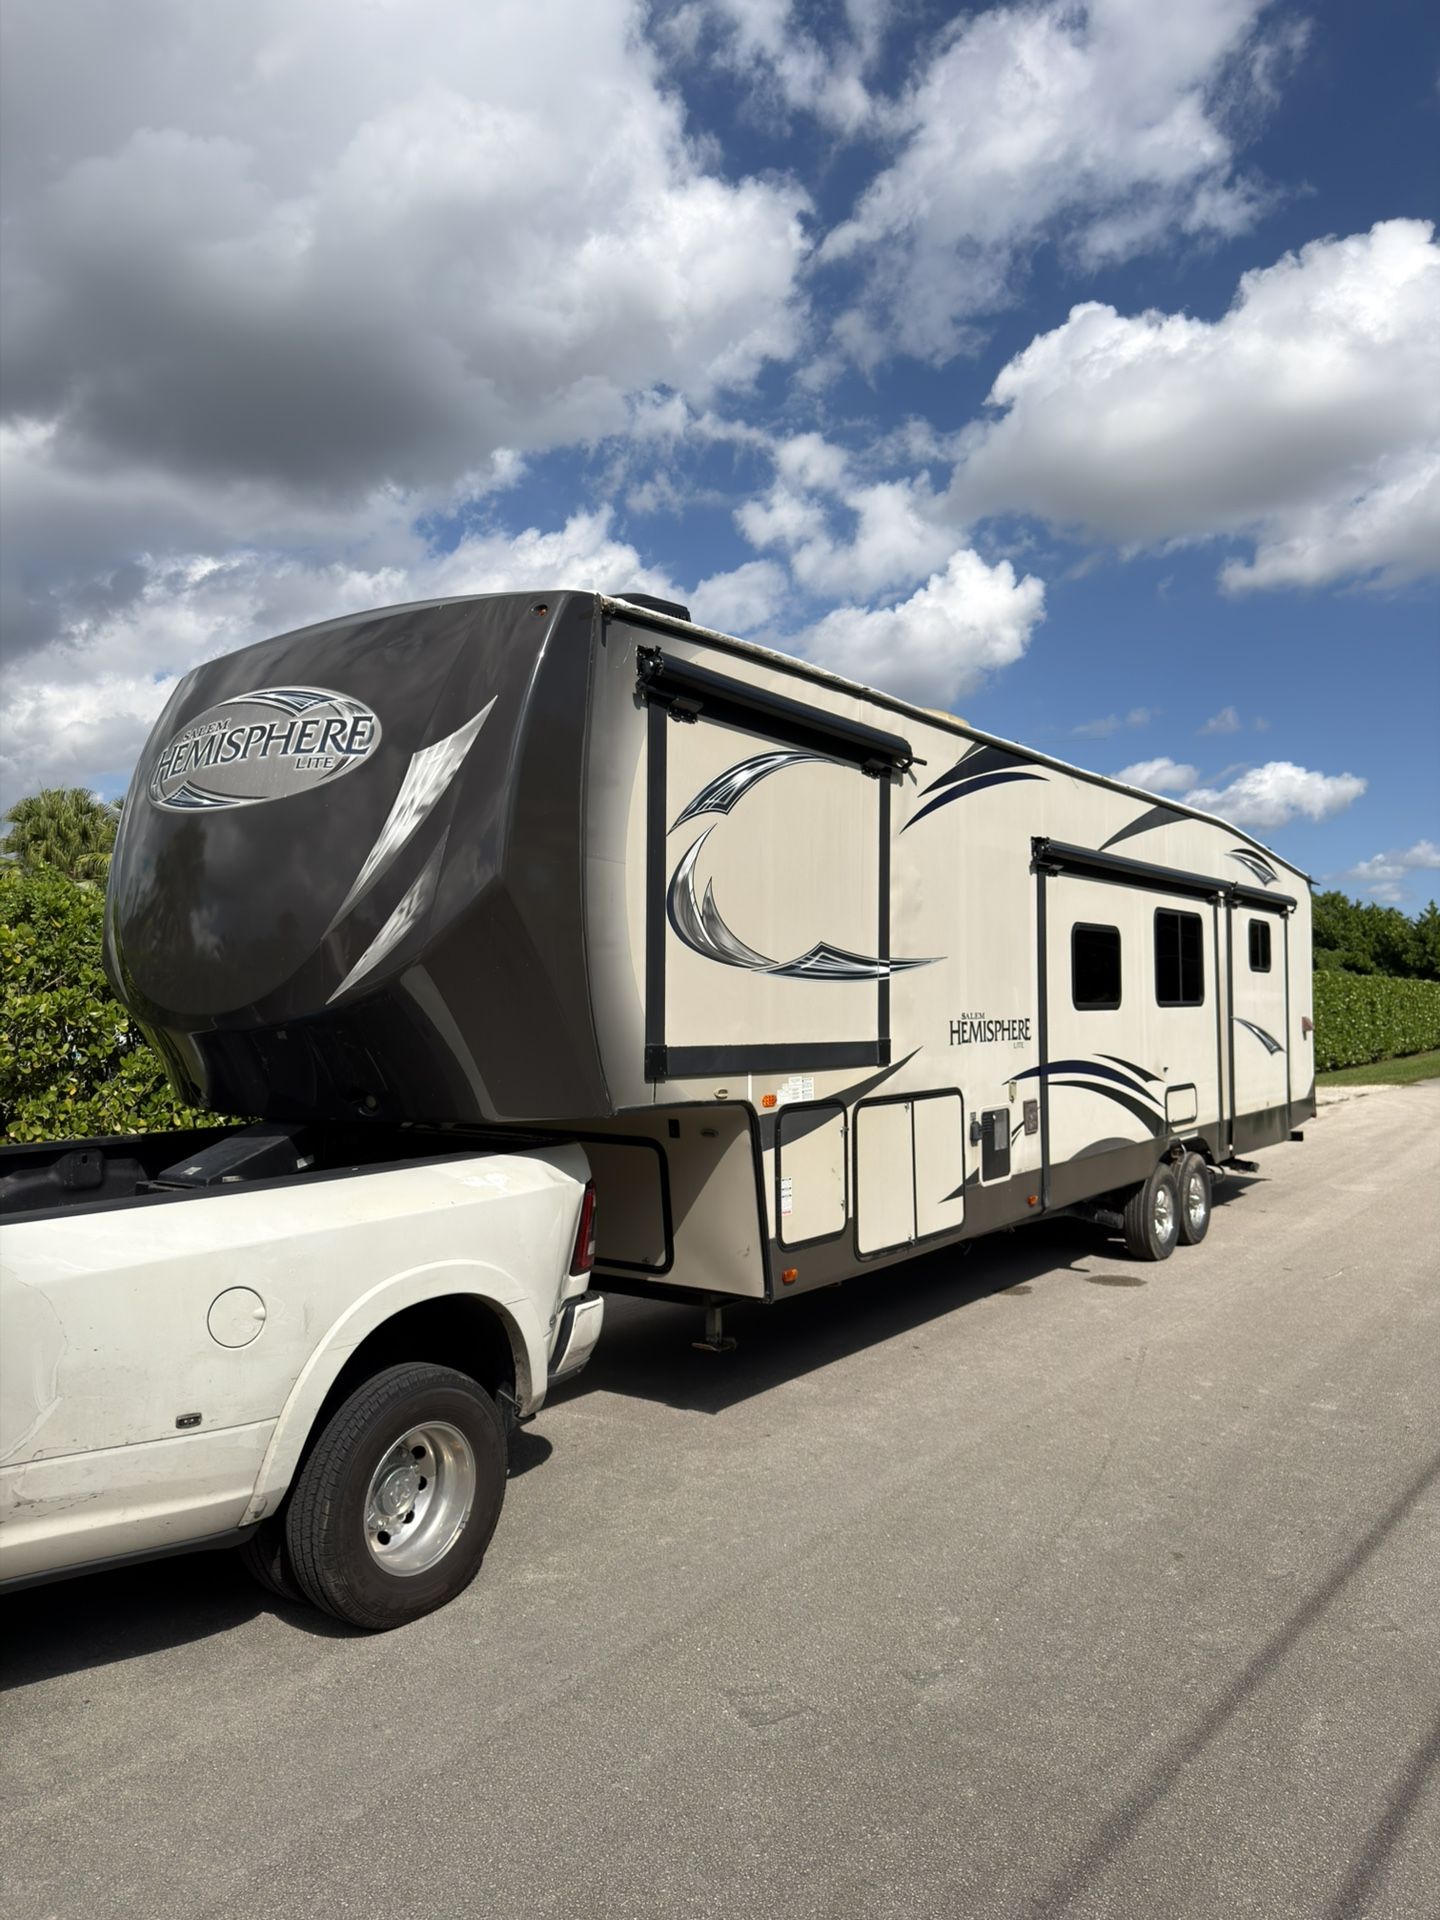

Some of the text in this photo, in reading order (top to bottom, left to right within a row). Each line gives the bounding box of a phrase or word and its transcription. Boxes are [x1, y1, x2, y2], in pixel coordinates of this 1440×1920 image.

[183, 718, 230, 741] SALEM
[153, 716, 374, 785] HEMISPHERE
[296, 757, 334, 769] LITE
[961, 1012, 985, 1020] SALEM
[949, 1018, 1031, 1046] HEMISPHERE
